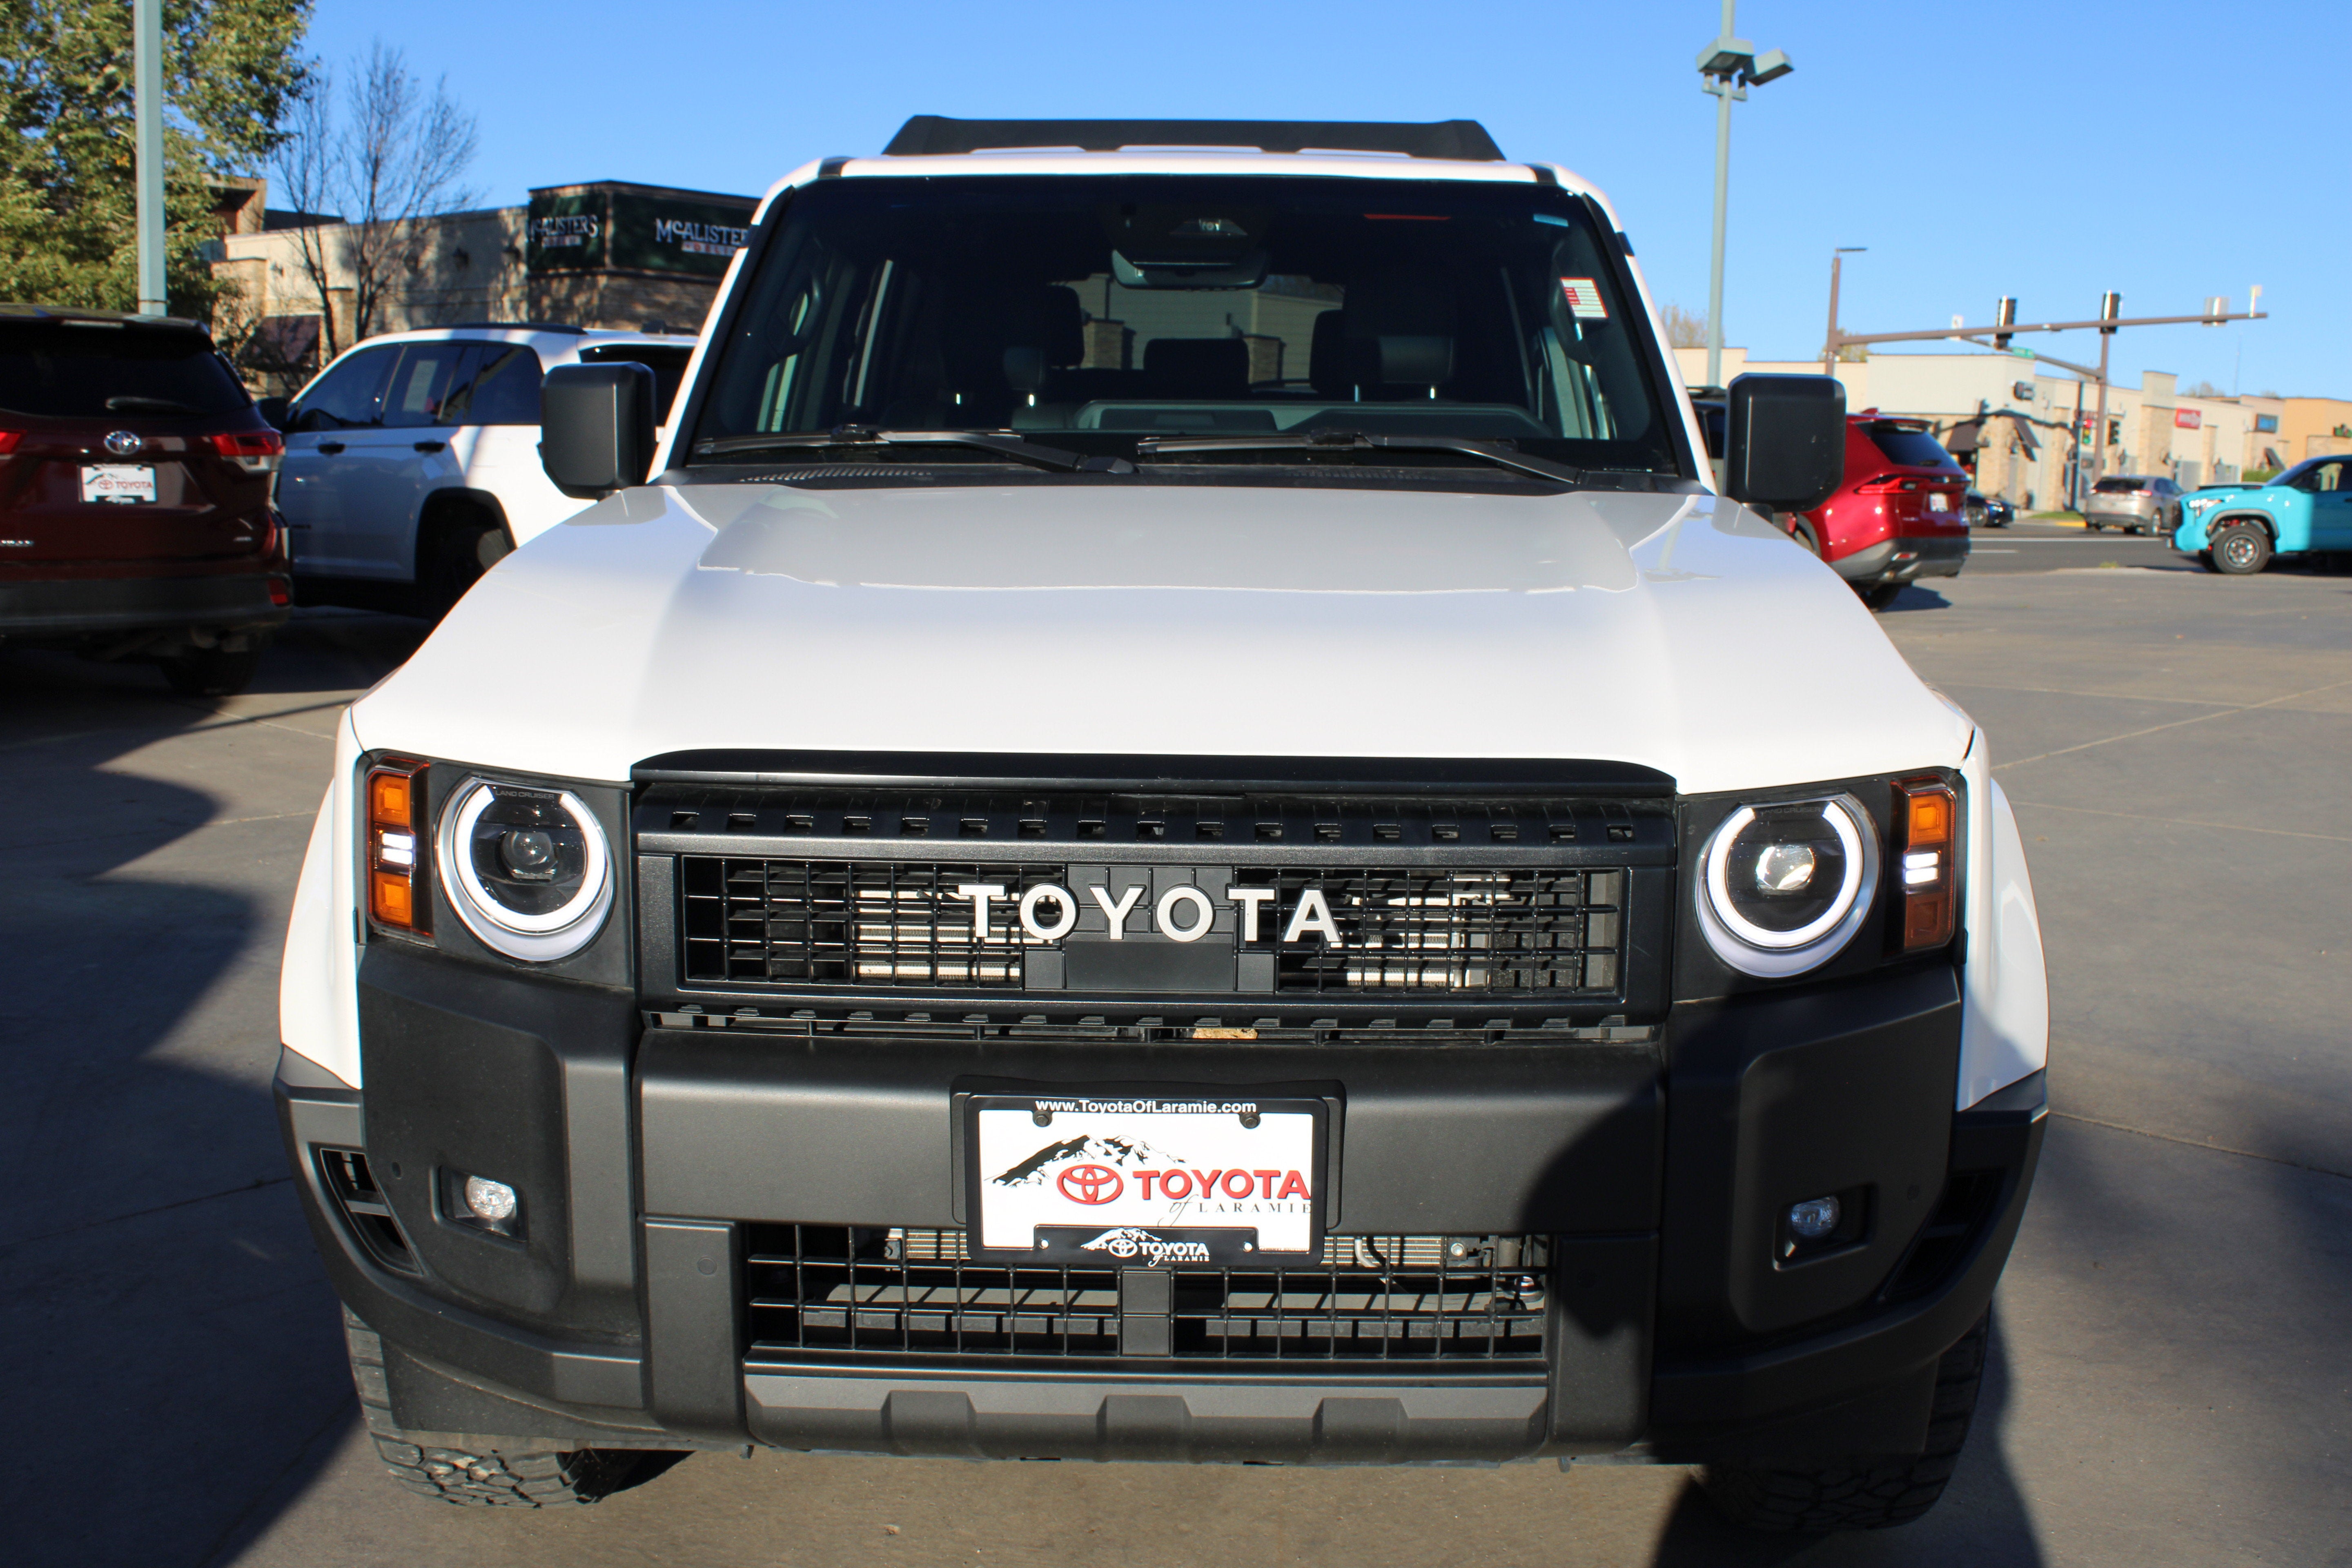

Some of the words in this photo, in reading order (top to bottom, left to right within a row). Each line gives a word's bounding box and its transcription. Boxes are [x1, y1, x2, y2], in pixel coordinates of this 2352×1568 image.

[116, 481, 152, 489] TOYOTA
[958, 883, 1342, 942] TOYOTA
[1035, 1099, 1256, 1114] www.ToyotaOfLaramie.com
[1132, 1169, 1311, 1200] TOYOTA
[1157, 1194, 1199, 1227] of
[1199, 1203, 1311, 1214] LARAMIE
[1138, 1242, 1209, 1256] TOYOTA
[1148, 1252, 1165, 1267] of
